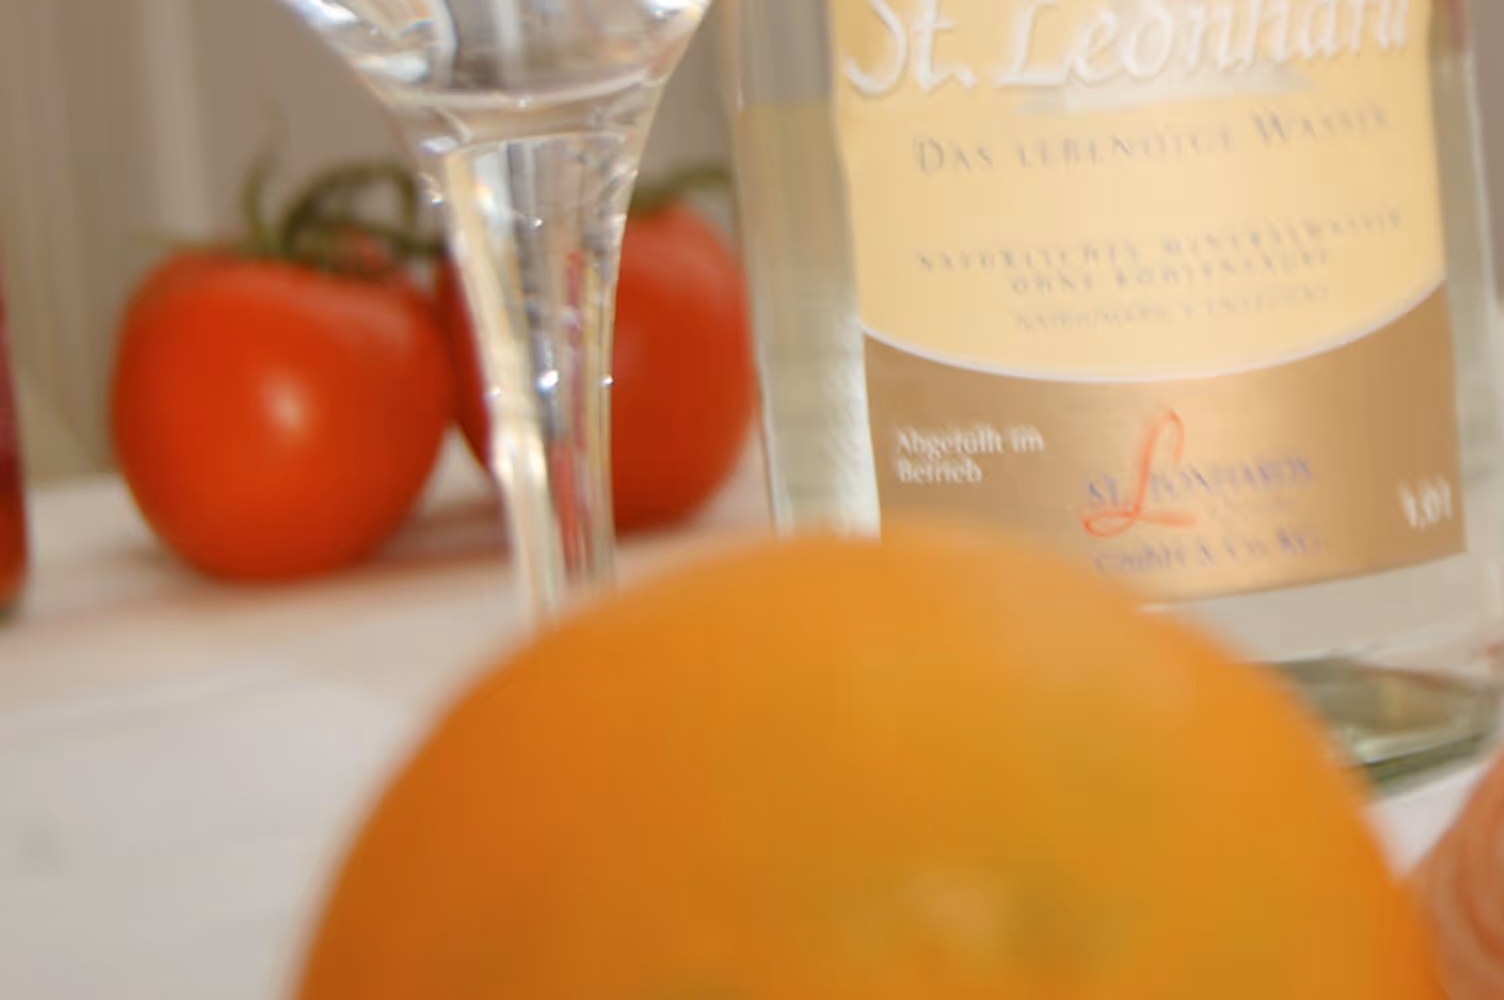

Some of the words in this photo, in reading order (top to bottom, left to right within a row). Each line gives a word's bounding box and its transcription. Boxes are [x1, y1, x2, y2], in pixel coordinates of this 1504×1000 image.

[893, 423, 1004, 461] Abgefüllt
[1010, 424, 1045, 453] im
[896, 454, 983, 485] Betrieb
